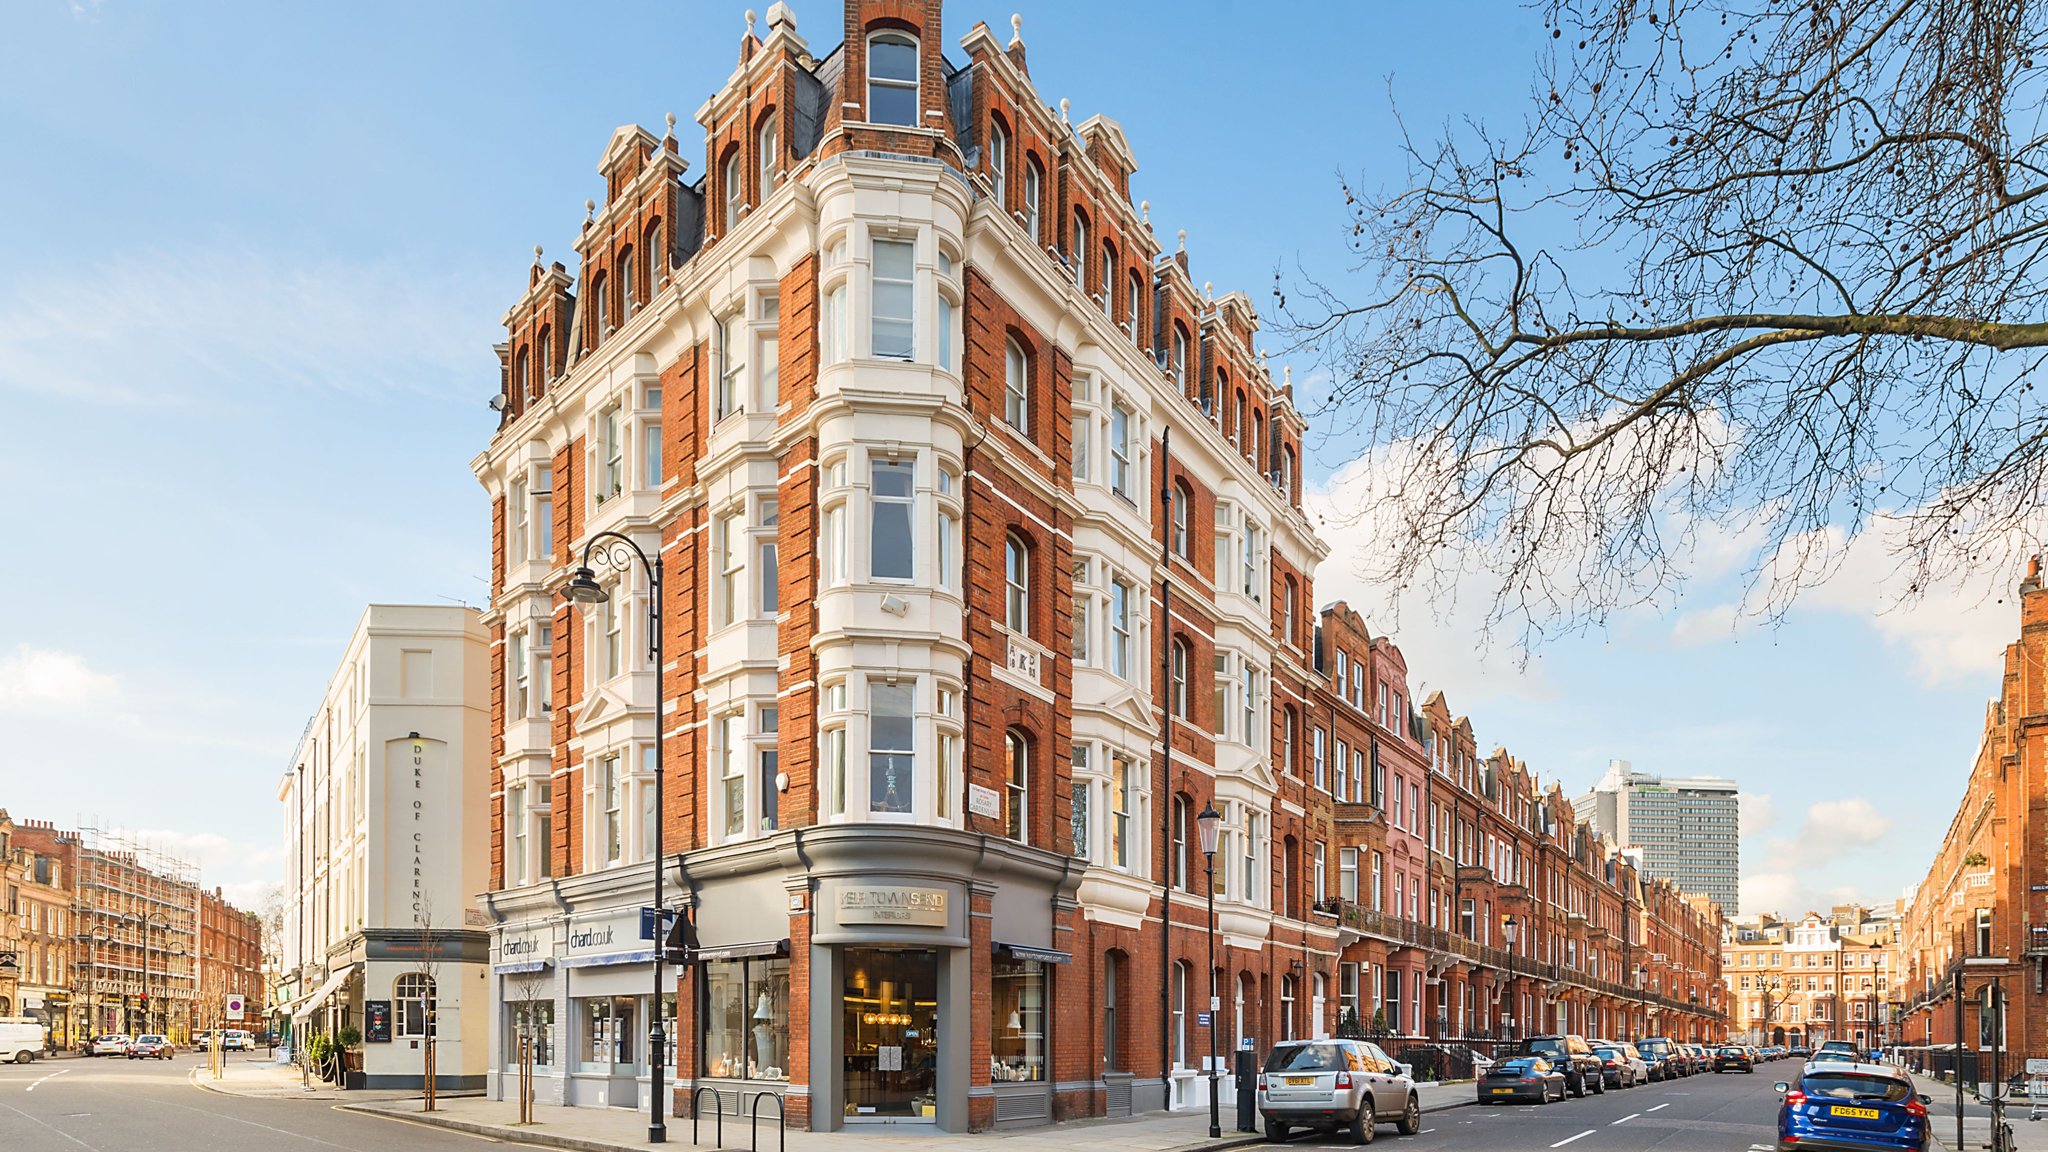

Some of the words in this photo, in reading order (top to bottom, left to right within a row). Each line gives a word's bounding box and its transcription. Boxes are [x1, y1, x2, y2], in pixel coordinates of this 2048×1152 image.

[1019, 653, 1028, 671] K
[414, 745, 422, 788] DUKE
[413, 800, 422, 821] OF
[412, 833, 421, 923] CLARENCE
[869, 891, 944, 907] TOWNSEND
[872, 910, 911, 920] INTERIORS
[503, 935, 540, 956] chard.co.uk
[570, 925, 614, 948] chard.co.uk
[1858, 1109, 1875, 1118] YXC
